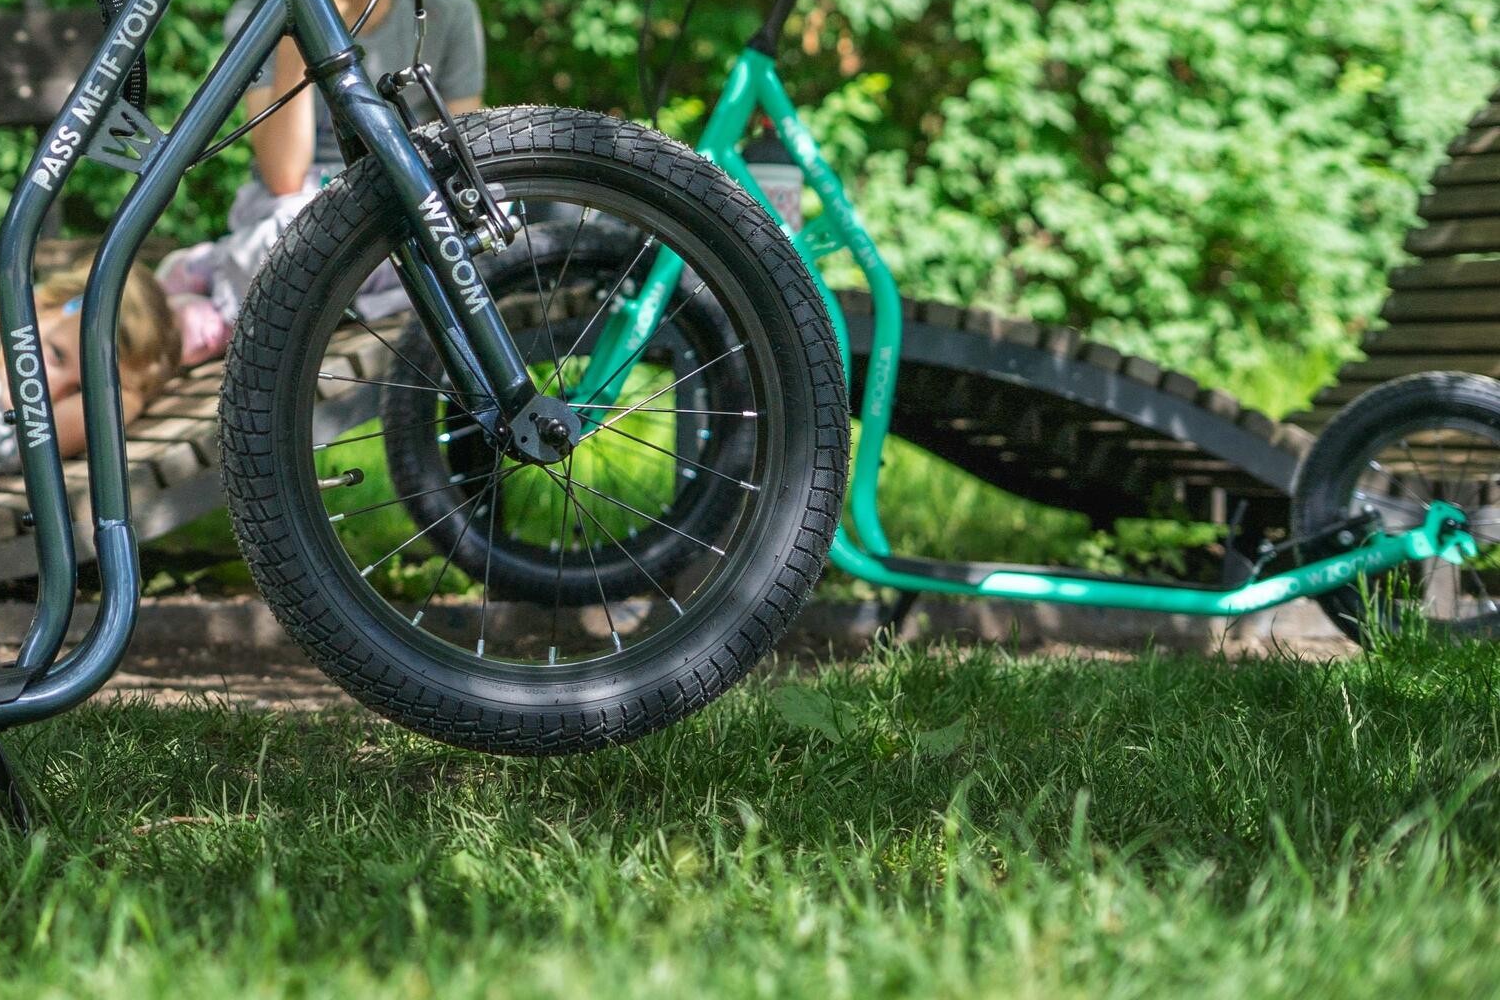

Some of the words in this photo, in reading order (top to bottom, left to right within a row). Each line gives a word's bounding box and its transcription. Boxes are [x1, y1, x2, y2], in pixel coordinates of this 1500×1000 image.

[31, 125, 81, 191] PASS
[71, 80, 108, 126] ME
[96, 53, 122, 81] IF
[418, 191, 489, 315] WZOOM
[11, 324, 51, 448] WZOOM
